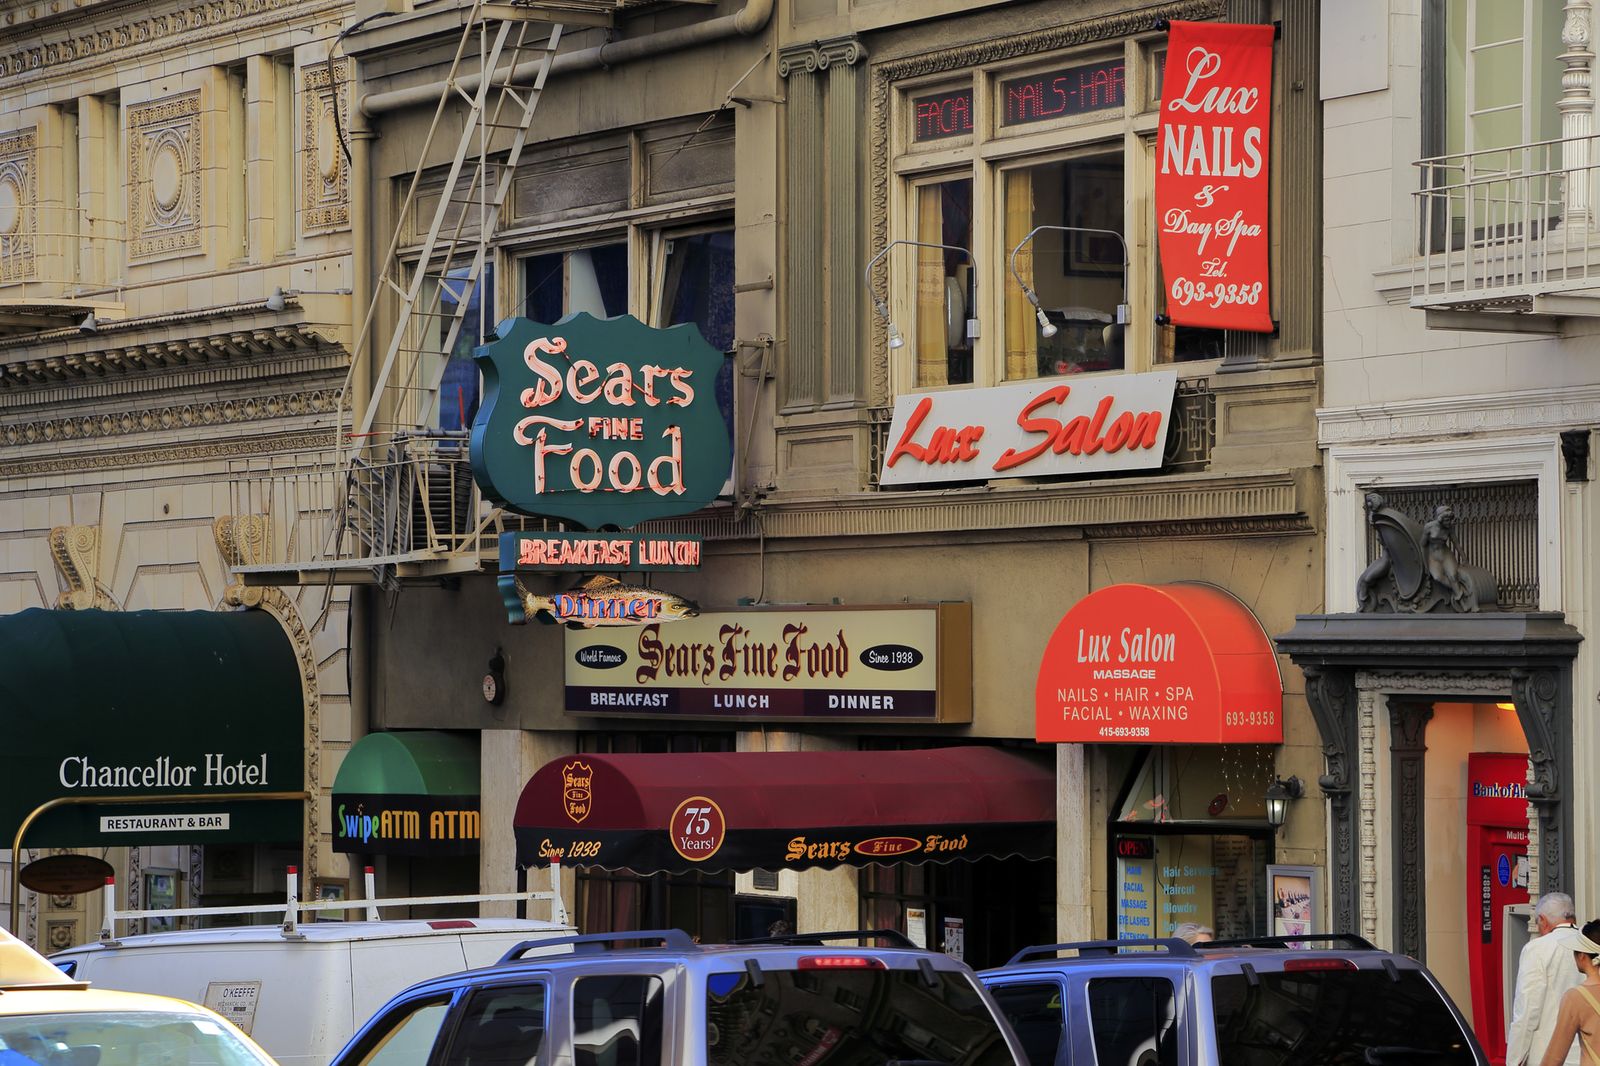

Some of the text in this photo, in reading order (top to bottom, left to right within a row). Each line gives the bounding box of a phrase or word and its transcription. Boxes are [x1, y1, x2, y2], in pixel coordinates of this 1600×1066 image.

[1168, 46, 1259, 115] Lux
[1161, 123, 1263, 179] NAILS
[1194, 185, 1230, 208] &
[1163, 208, 1262, 257] Day Spa
[1200, 257, 1228, 278] Tel.
[1171, 277, 1263, 309] 693-9358
[520, 336, 695, 408] Sears
[588, 416, 644, 441] FINE
[886, 385, 1163, 472] Lux Salon
[513, 415, 688, 496] Food
[517, 538, 700, 566] BREAKFAST LUNCH
[554, 592, 662, 619] Dinner
[635, 621, 849, 686] Sears Fine Food
[1077, 627, 1176, 663] Lux Salon
[580, 650, 622, 663] World Famous
[868, 650, 914, 664] Since 1938
[1093, 669, 1156, 680] MASSAGE
[590, 692, 669, 707] BREAKFAST
[714, 694, 769, 708] LUNCH
[828, 695, 894, 710] DINNER
[1057, 686, 1194, 702] NAILS HAIR SPA
[1063, 705, 1188, 721] FACIAL WAXING
[1226, 711, 1275, 726] 693-9358
[1099, 727, 1150, 737] 415-693-9358
[59, 753, 269, 788] Chancellor Hotel
[566, 773, 590, 791] Sears
[1473, 782, 1501, 798] Bank
[572, 792, 583, 800] Fine
[569, 801, 587, 816] Food
[107, 816, 222, 830] RESTAURANT & BAR
[430, 810, 480, 840] ATM
[684, 806, 712, 835] 75
[538, 838, 602, 858] Since 1938
[680, 836, 714, 851] Years!
[785, 833, 969, 862] Sears Fine Food
[1163, 866, 1181, 878] Hair
[1124, 882, 1144, 893] FACIAL
[1163, 884, 1196, 895] Haircut
[1121, 898, 1147, 909] MASSAGE
[1130, 916, 1150, 927] LASHES
